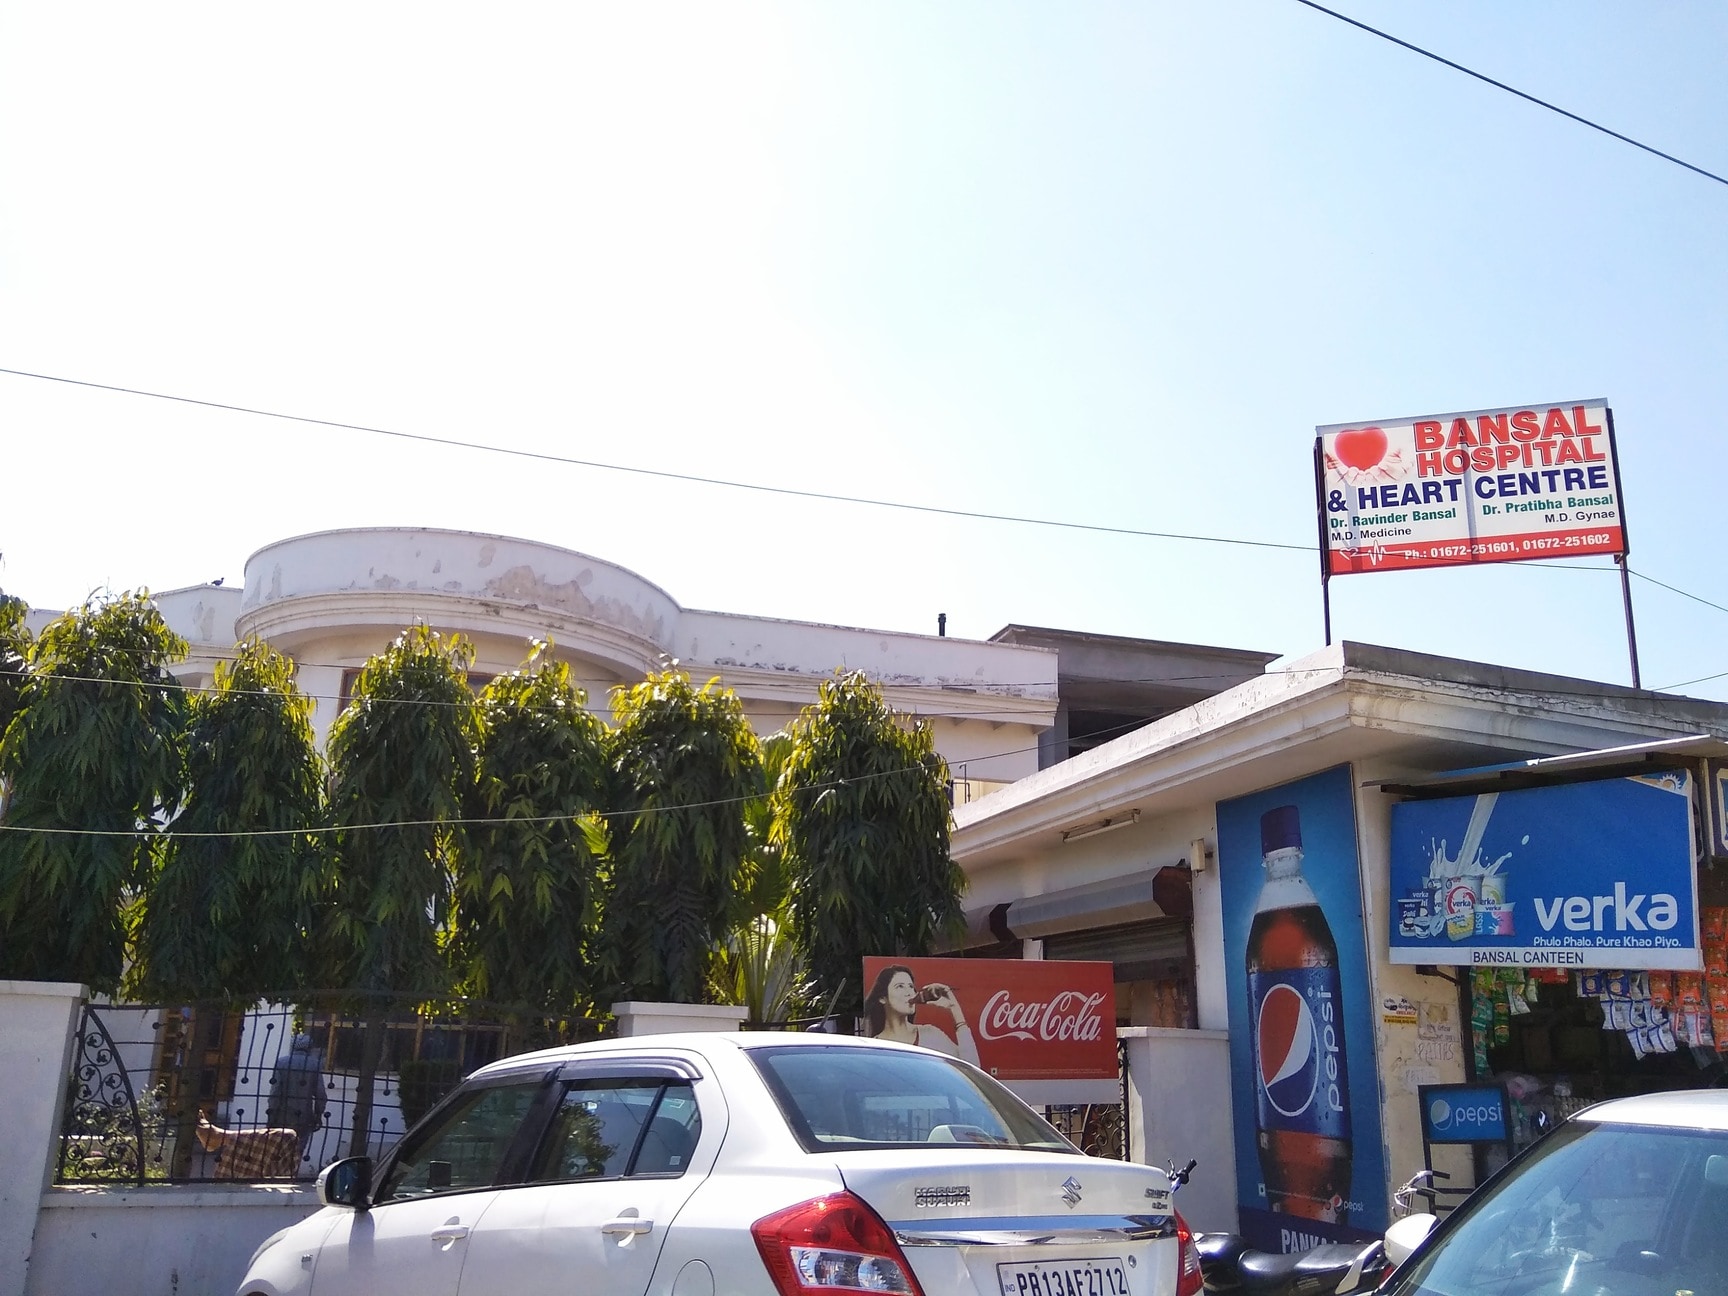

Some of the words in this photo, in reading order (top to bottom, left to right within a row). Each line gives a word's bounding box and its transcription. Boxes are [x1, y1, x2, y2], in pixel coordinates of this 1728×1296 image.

[1413, 405, 1602, 452] BANSAL
[1416, 437, 1606, 478] HOSPITAL
[1327, 489, 1348, 512] &
[1358, 479, 1462, 510] HEART
[1475, 465, 1609, 499] CENTRE
[1482, 504, 1501, 516] Dr.
[1505, 499, 1563, 514] Pratibha
[1567, 493, 1614, 508] Bansal
[1545, 513, 1572, 523] M.D.
[1575, 509, 1616, 524] Gynae
[1330, 516, 1348, 528] Dr.
[1352, 511, 1410, 526] Ravinder
[1413, 507, 1457, 521] Bansal
[1331, 531, 1357, 541] M.D.
[1360, 526, 1412, 539] Medicine
[1430, 541, 1520, 558] 01672-251601,
[1522, 533, 1611, 551] 01672-251602
[1533, 881, 1679, 932] verka
[1533, 935, 1562, 947] Phulo
[1563, 935, 1594, 947] Phalo.
[1596, 936, 1621, 948] Pure
[1623, 936, 1653, 948] Khao
[1655, 936, 1682, 949] Piyo.
[1473, 950, 1519, 964] BANSAL
[1523, 951, 1585, 965] CANTEEN
[979, 989, 1107, 1042] Coca-Cola
[1318, 990, 1343, 1112] pepsi
[1455, 1101, 1503, 1127] pepsi
[914, 1196, 970, 1207] SUZUKI
[1016, 1267, 1128, 1296] PB13AF2712
